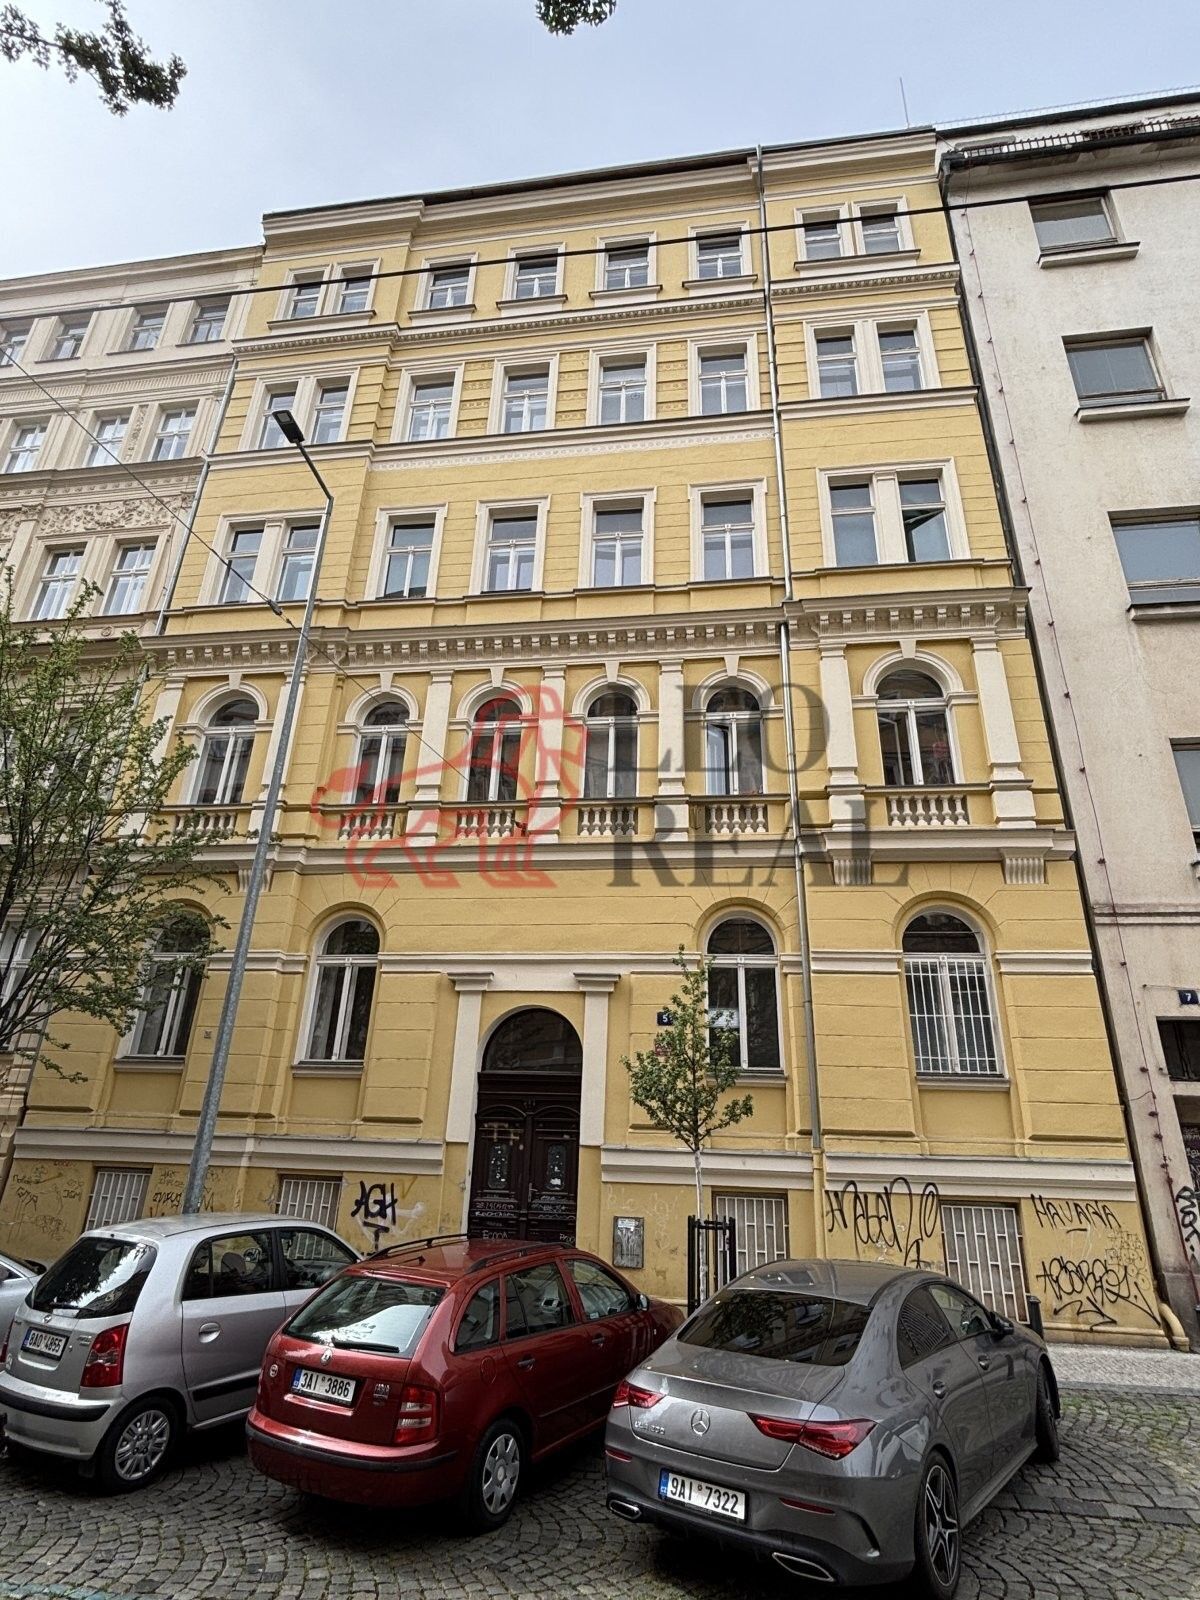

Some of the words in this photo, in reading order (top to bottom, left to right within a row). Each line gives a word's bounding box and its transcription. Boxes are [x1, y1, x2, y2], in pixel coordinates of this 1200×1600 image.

[324, 1377, 351, 1398] 3886
[670, 1477, 693, 1501] 9AI
[704, 1485, 739, 1515] 7322
